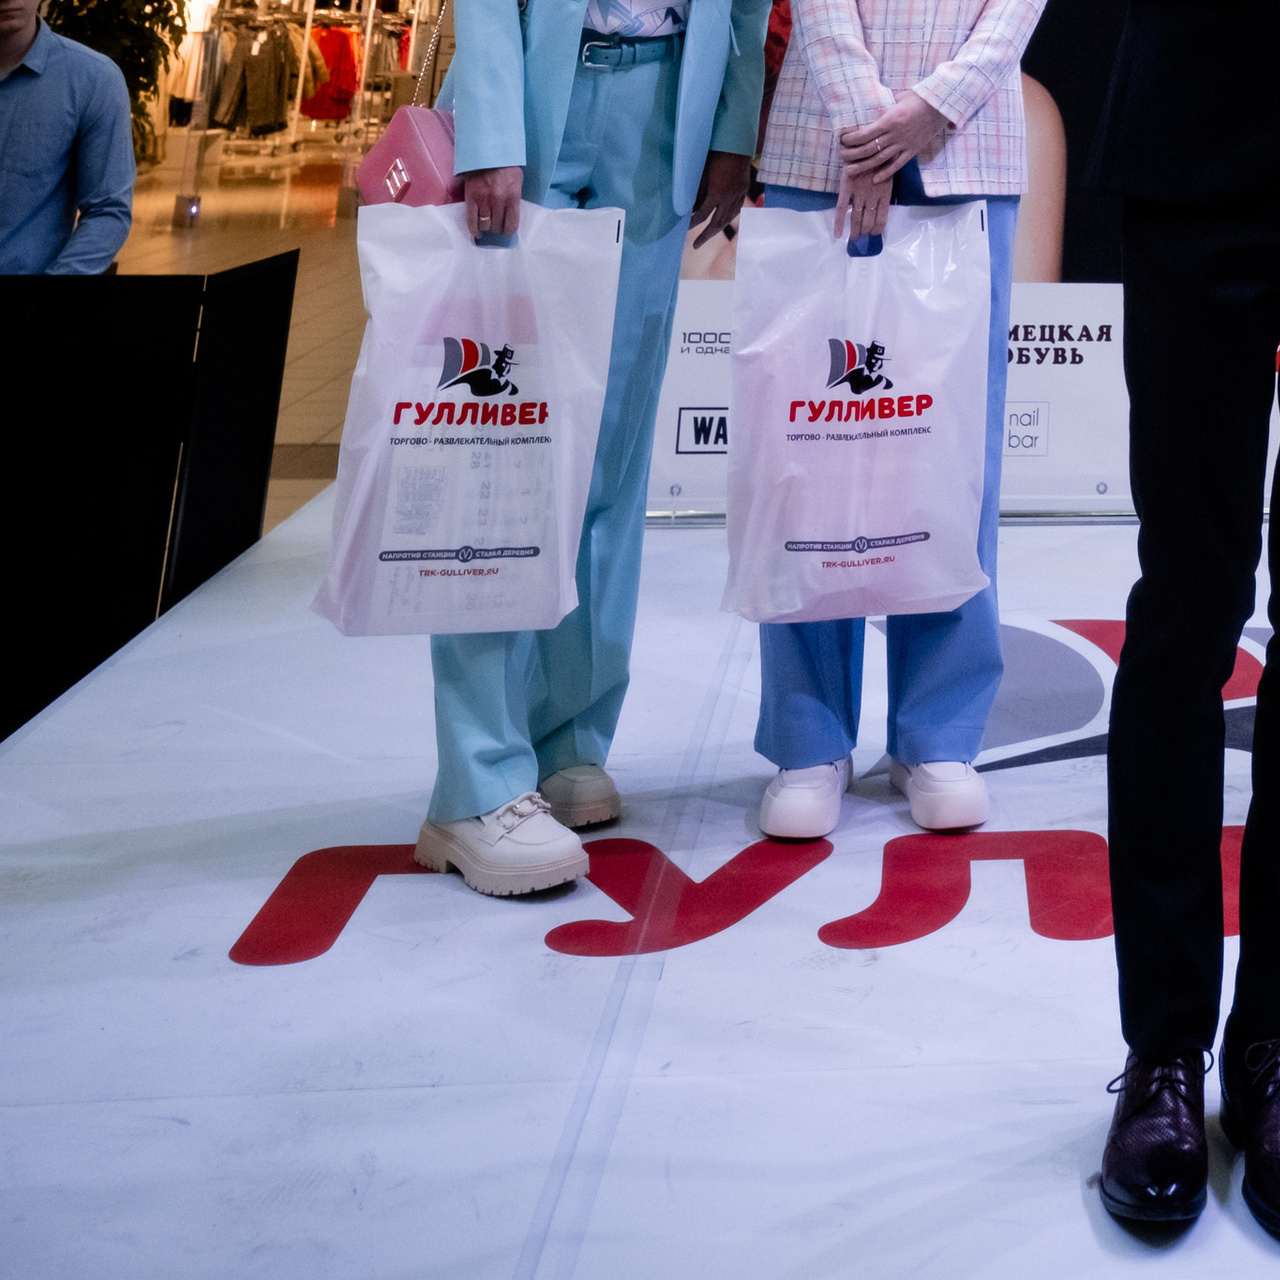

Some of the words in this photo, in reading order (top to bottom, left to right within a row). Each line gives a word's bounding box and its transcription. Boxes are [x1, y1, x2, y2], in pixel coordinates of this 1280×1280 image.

[789, 394, 934, 423] ГУЛЛИВЕР
[1009, 408, 1039, 427] nail
[390, 437, 428, 445] ТОРГОВО
[433, 437, 509, 446] РАЗВЛЕКАТЕЛЬНЫЙ
[511, 436, 552, 445] КОМПЛЕК
[786, 433, 821, 442] ТОРГОВО
[890, 426, 932, 437] КОМПЛЕКС
[1008, 429, 1039, 449] bar
[870, 538, 895, 547] СТАРАЯ
[821, 556, 895, 568] TRK-GULLIVER.RU
[419, 568, 499, 577] TRK-GULLIVER.RU
